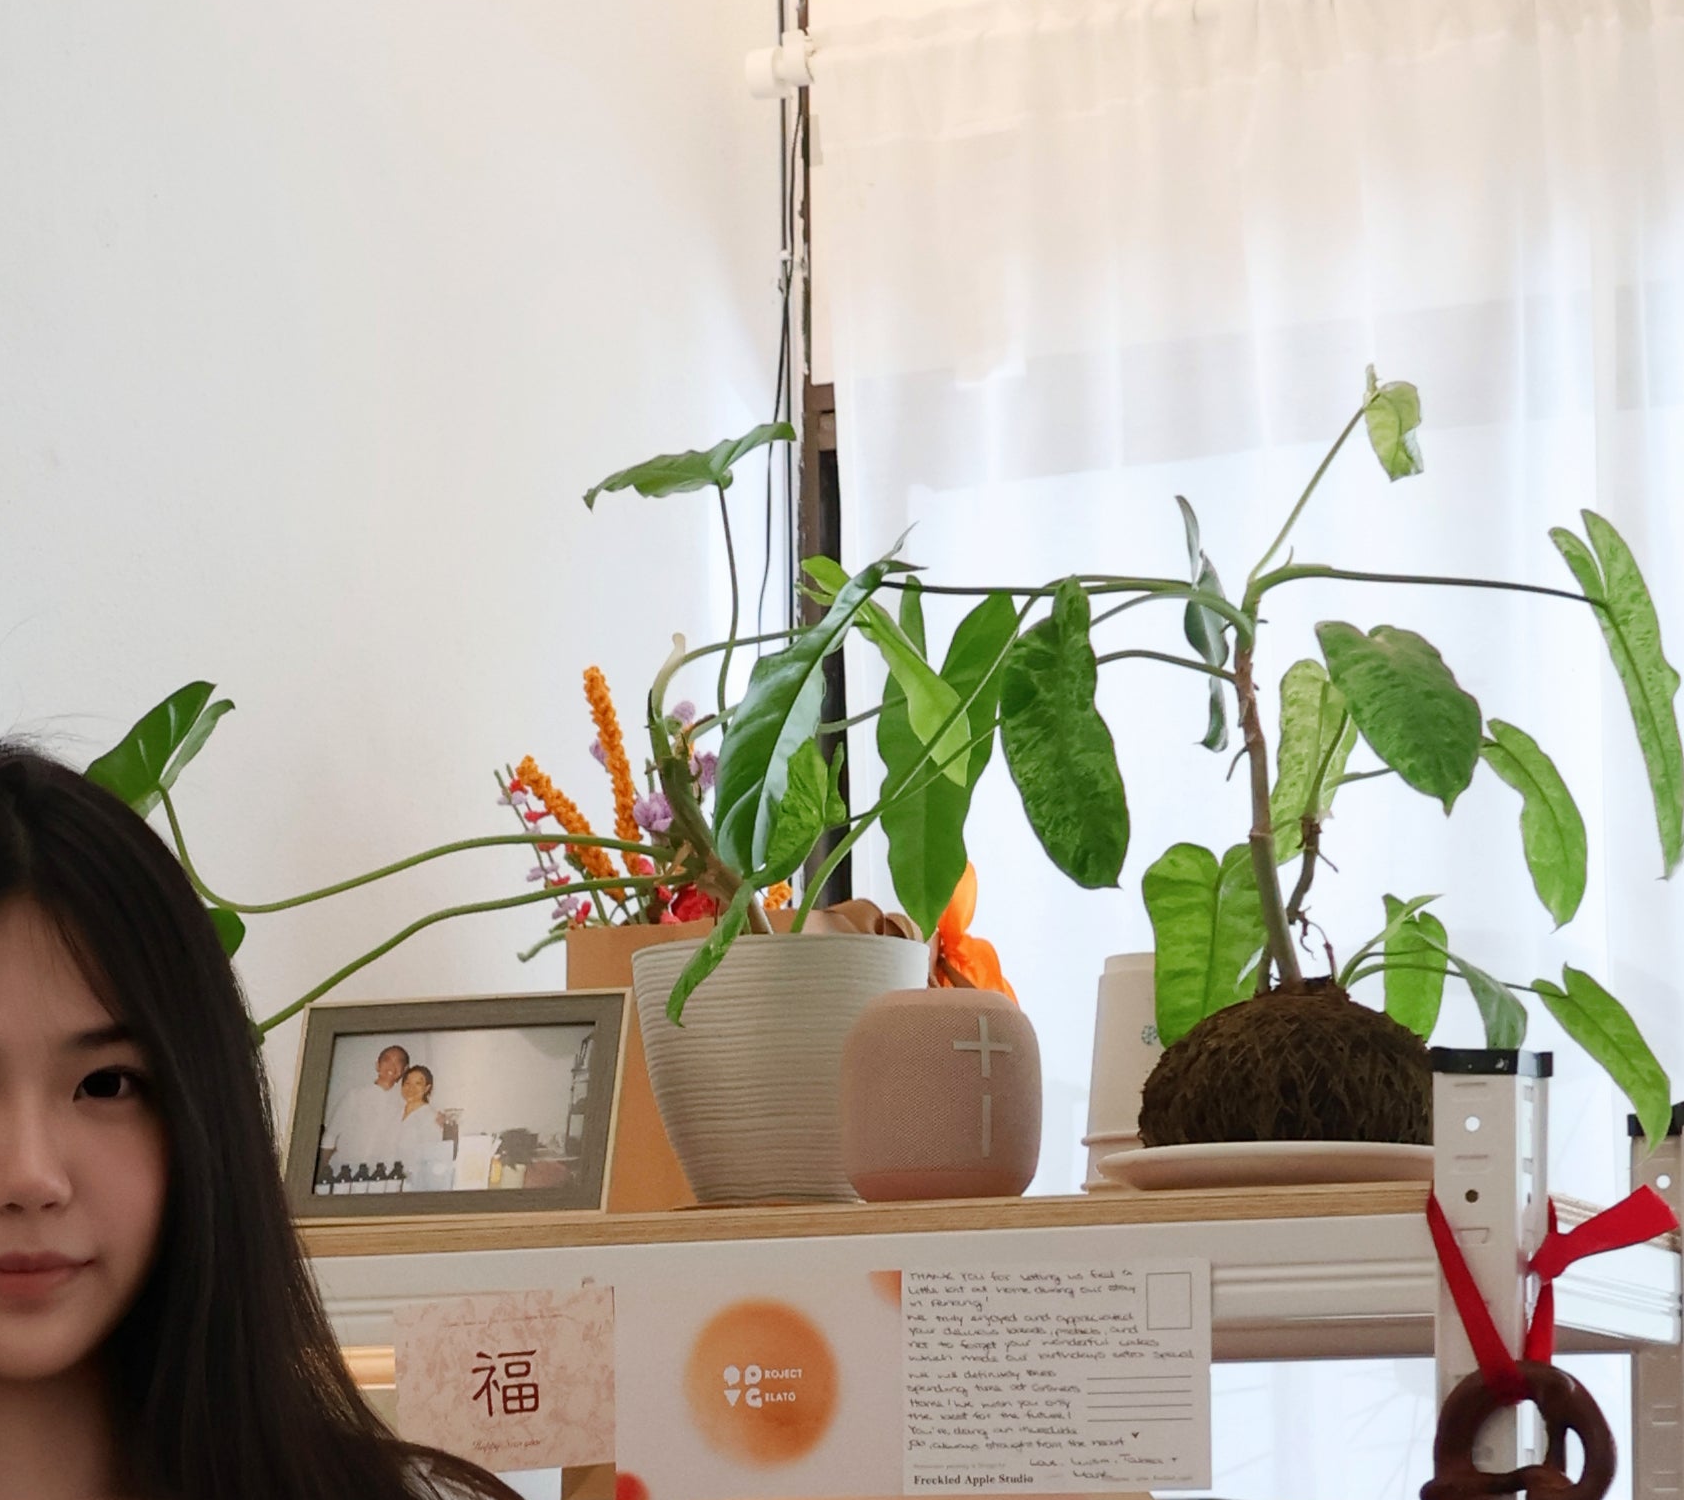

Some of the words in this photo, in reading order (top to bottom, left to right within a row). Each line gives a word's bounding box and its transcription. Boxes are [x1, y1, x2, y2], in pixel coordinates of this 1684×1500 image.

[472, 1349, 540, 1418] 福
[745, 1364, 803, 1386] PROJECT
[913, 1474, 961, 1485] Freckled
[964, 1473, 996, 1486] Apple
[998, 1473, 1034, 1485] Studio
